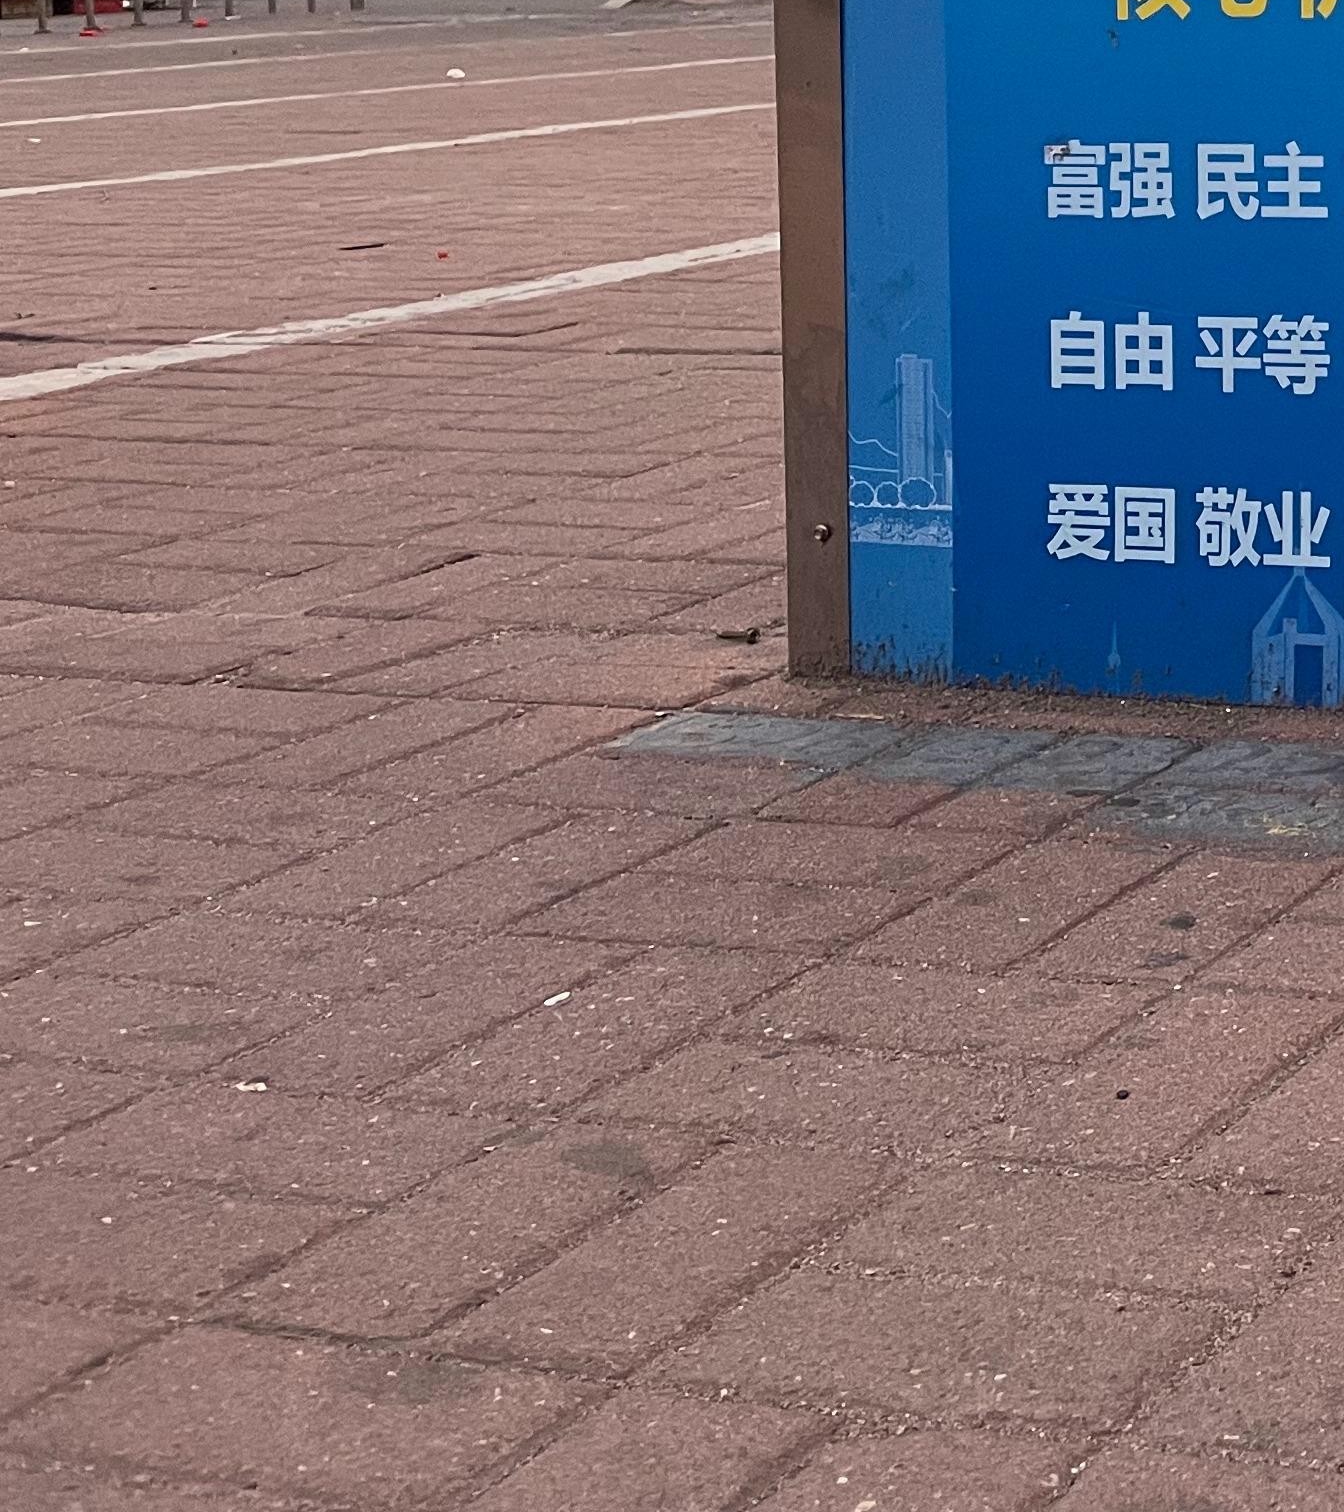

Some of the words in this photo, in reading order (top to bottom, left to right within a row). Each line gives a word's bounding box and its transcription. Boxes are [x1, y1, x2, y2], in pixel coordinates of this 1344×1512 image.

[1044, 140, 1176, 220] 富强
[1195, 141, 1328, 220] 民主
[1049, 311, 1174, 391] 自由
[1195, 314, 1331, 395] 平等
[1046, 483, 1176, 564] 爱国
[1195, 486, 1331, 568] 敬业
